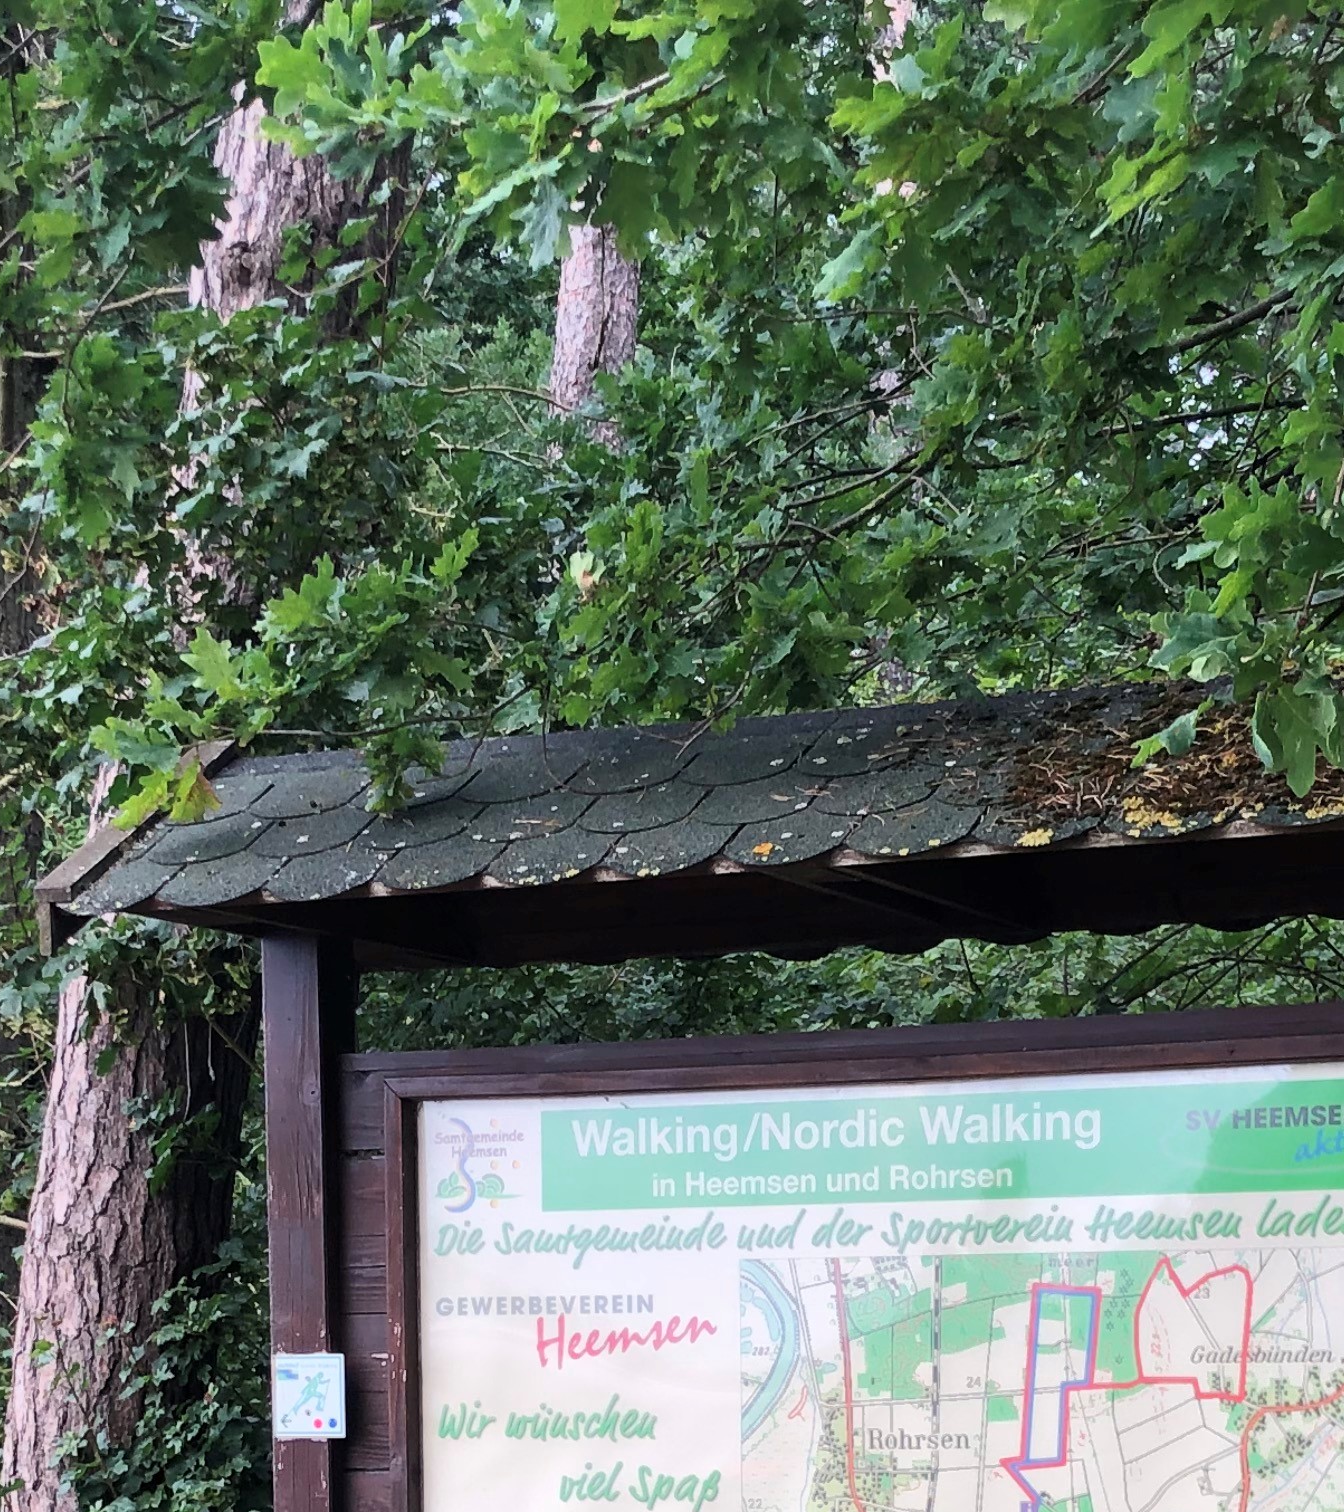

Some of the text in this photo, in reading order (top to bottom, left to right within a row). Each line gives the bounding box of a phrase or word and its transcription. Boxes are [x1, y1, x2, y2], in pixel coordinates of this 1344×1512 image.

[1185, 1108, 1221, 1131] SV
[433, 1129, 526, 1146] Samtgemeinde
[571, 1101, 1101, 1162] Walking/Nordic Walking
[451, 1145, 508, 1158] Heemsen
[652, 1163, 1013, 1198] in Heemsen und Rohrsen
[433, 1218, 485, 1257] Die
[494, 1210, 727, 1269] Samtgemeinde
[736, 1207, 807, 1251] und
[811, 1206, 873, 1248] der
[880, 1204, 1074, 1255] Sportverein
[1084, 1203, 1243, 1243] Heemsen
[435, 1293, 654, 1317] GEWERBEVEREIN
[536, 1311, 718, 1370] Heemsen
[1190, 1344, 1335, 1365] Gadesbünden
[966, 1376, 982, 1388] 24
[436, 1392, 659, 1443] Wir wünschen
[867, 1427, 970, 1450] Rohrsen
[559, 1460, 624, 1503] viel
[748, 1498, 763, 1510] 22
